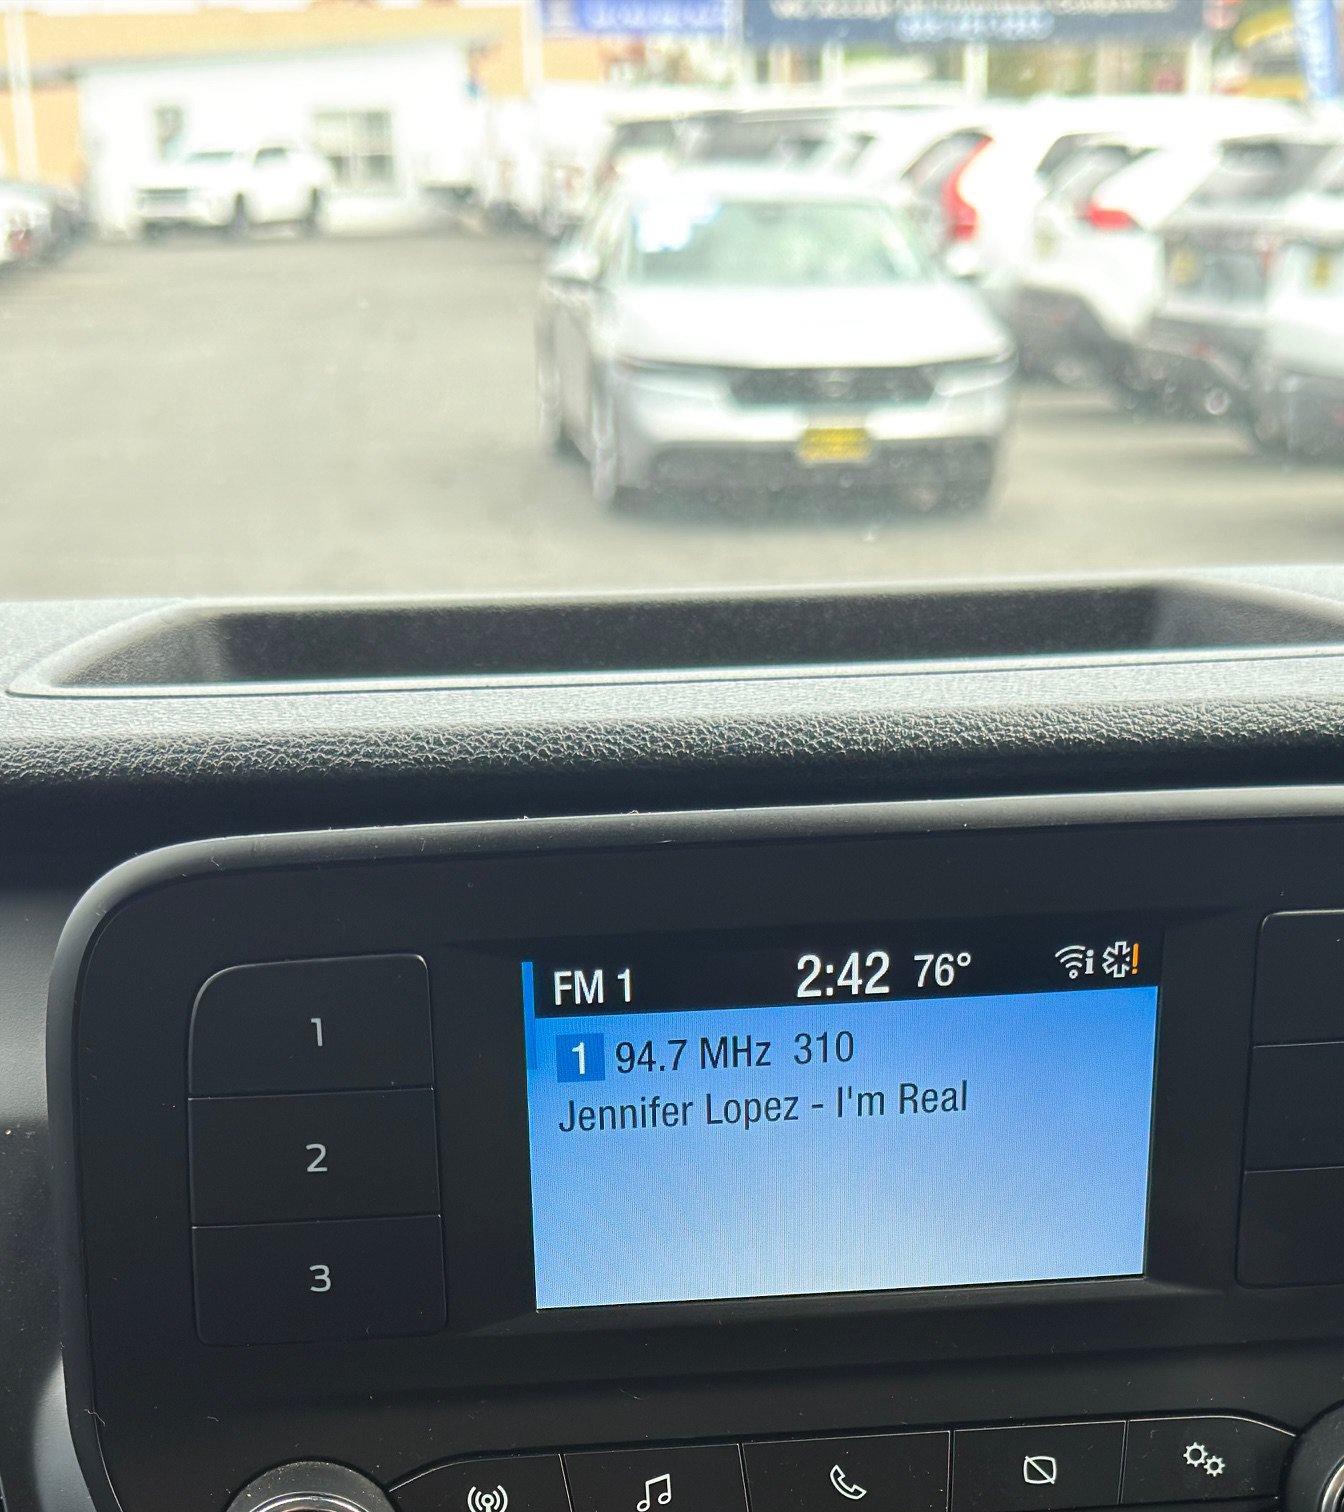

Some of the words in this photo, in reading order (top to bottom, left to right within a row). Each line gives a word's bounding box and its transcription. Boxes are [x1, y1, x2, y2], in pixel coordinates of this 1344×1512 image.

[553, 969, 604, 1006] FM
[616, 968, 636, 1004] 1
[796, 950, 891, 999] 2:42
[913, 952, 972, 988] 76°
[310, 1017, 323, 1047] 1
[570, 1040, 589, 1077] 1
[615, 1039, 688, 1074] 94.7
[700, 1034, 772, 1070] MHz
[792, 1029, 856, 1067] 310
[558, 1095, 694, 1133] Jennifer
[705, 1093, 799, 1131] Lopez
[837, 1085, 885, 1118] I'm
[899, 1079, 968, 1115] Real
[305, 1143, 328, 1173] 2
[309, 1264, 332, 1292] 3
